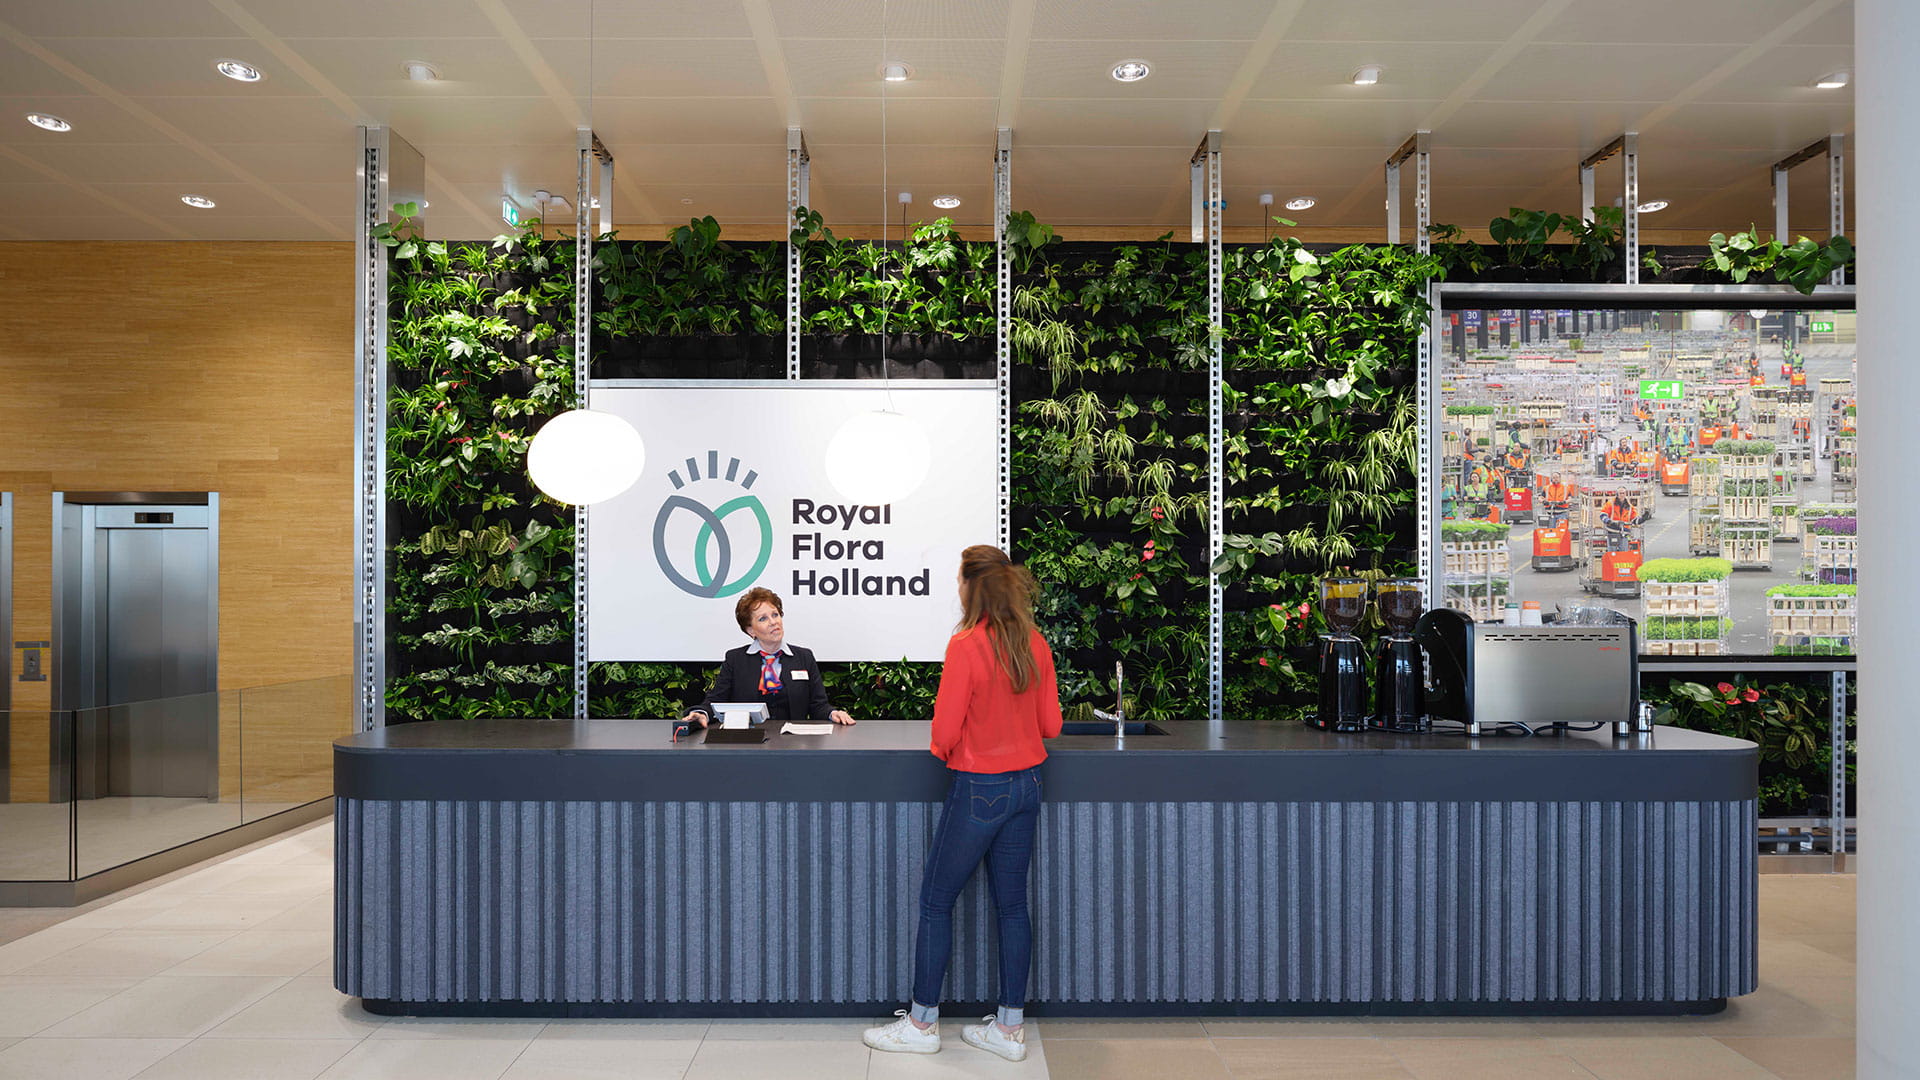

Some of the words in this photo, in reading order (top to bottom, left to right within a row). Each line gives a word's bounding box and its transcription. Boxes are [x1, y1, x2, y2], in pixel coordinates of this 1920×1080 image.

[1467, 311, 1478, 320] 30
[792, 498, 891, 531] Royal
[792, 532, 884, 561] Flora
[792, 568, 930, 597] Holland
